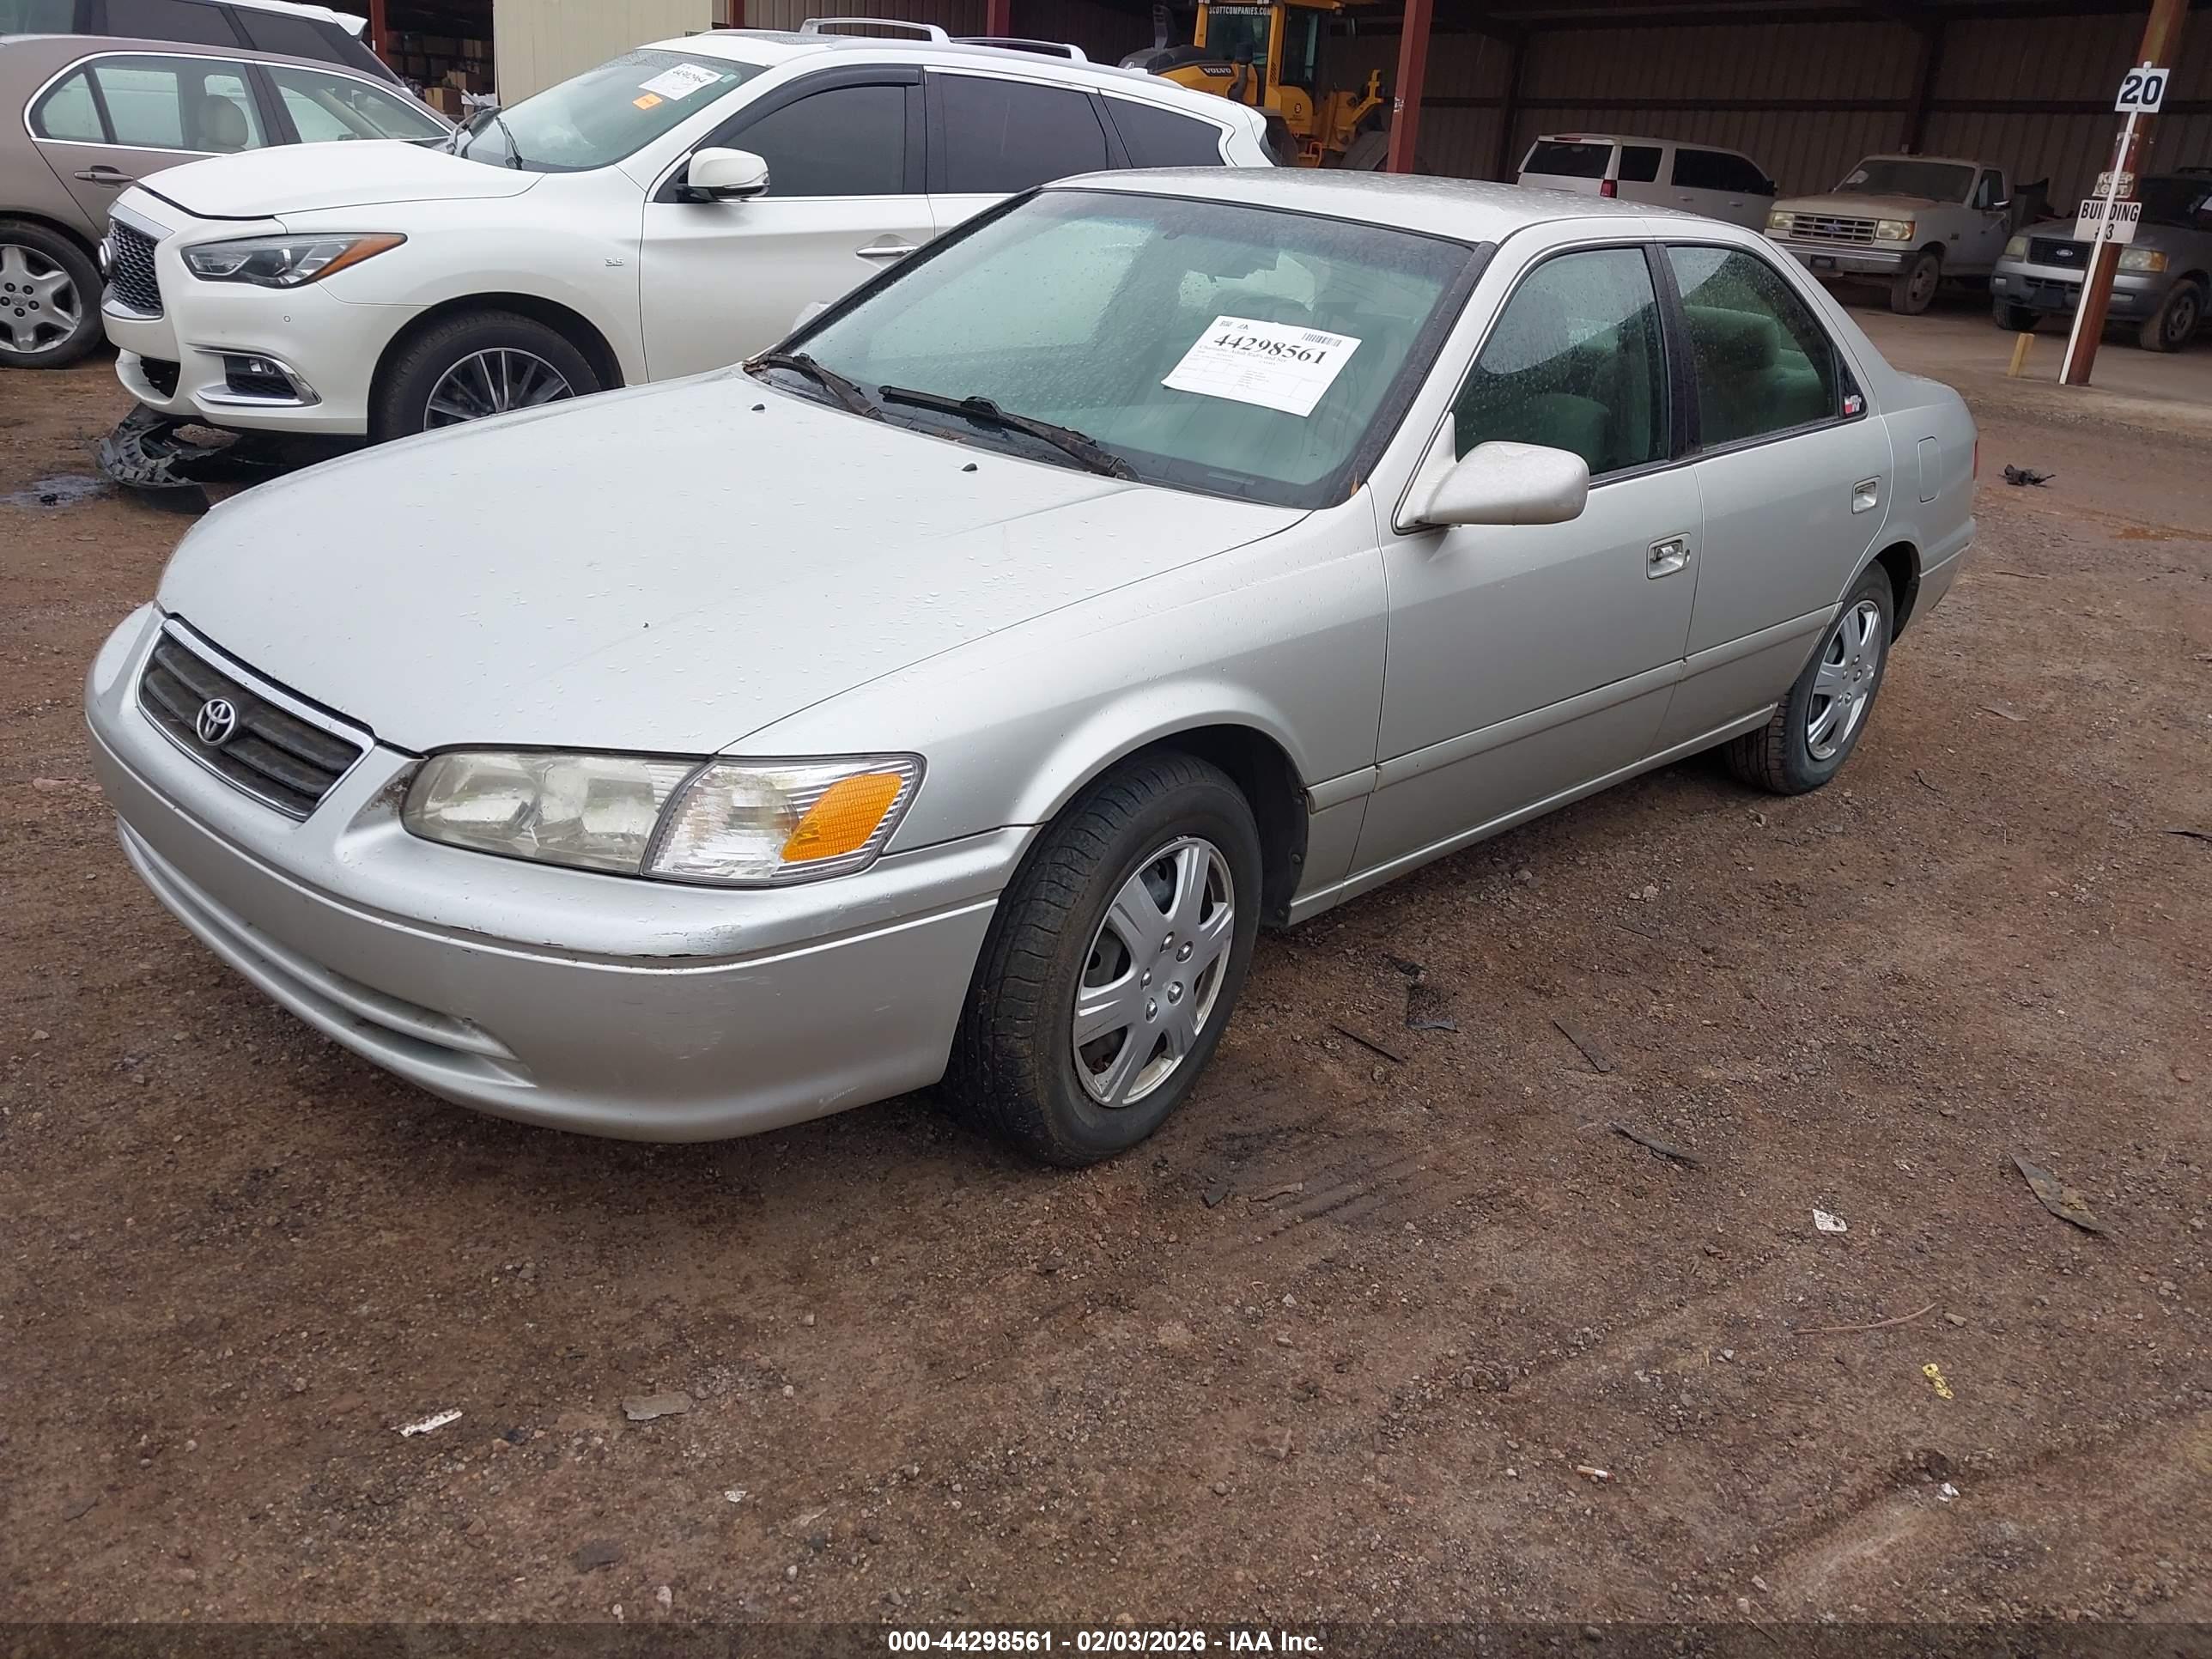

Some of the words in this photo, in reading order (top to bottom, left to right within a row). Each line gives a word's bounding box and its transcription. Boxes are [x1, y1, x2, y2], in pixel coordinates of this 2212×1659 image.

[2120, 76, 2163, 105] 20
[2100, 183, 2129, 195] OT
[1213, 333, 1327, 365] 44298561
